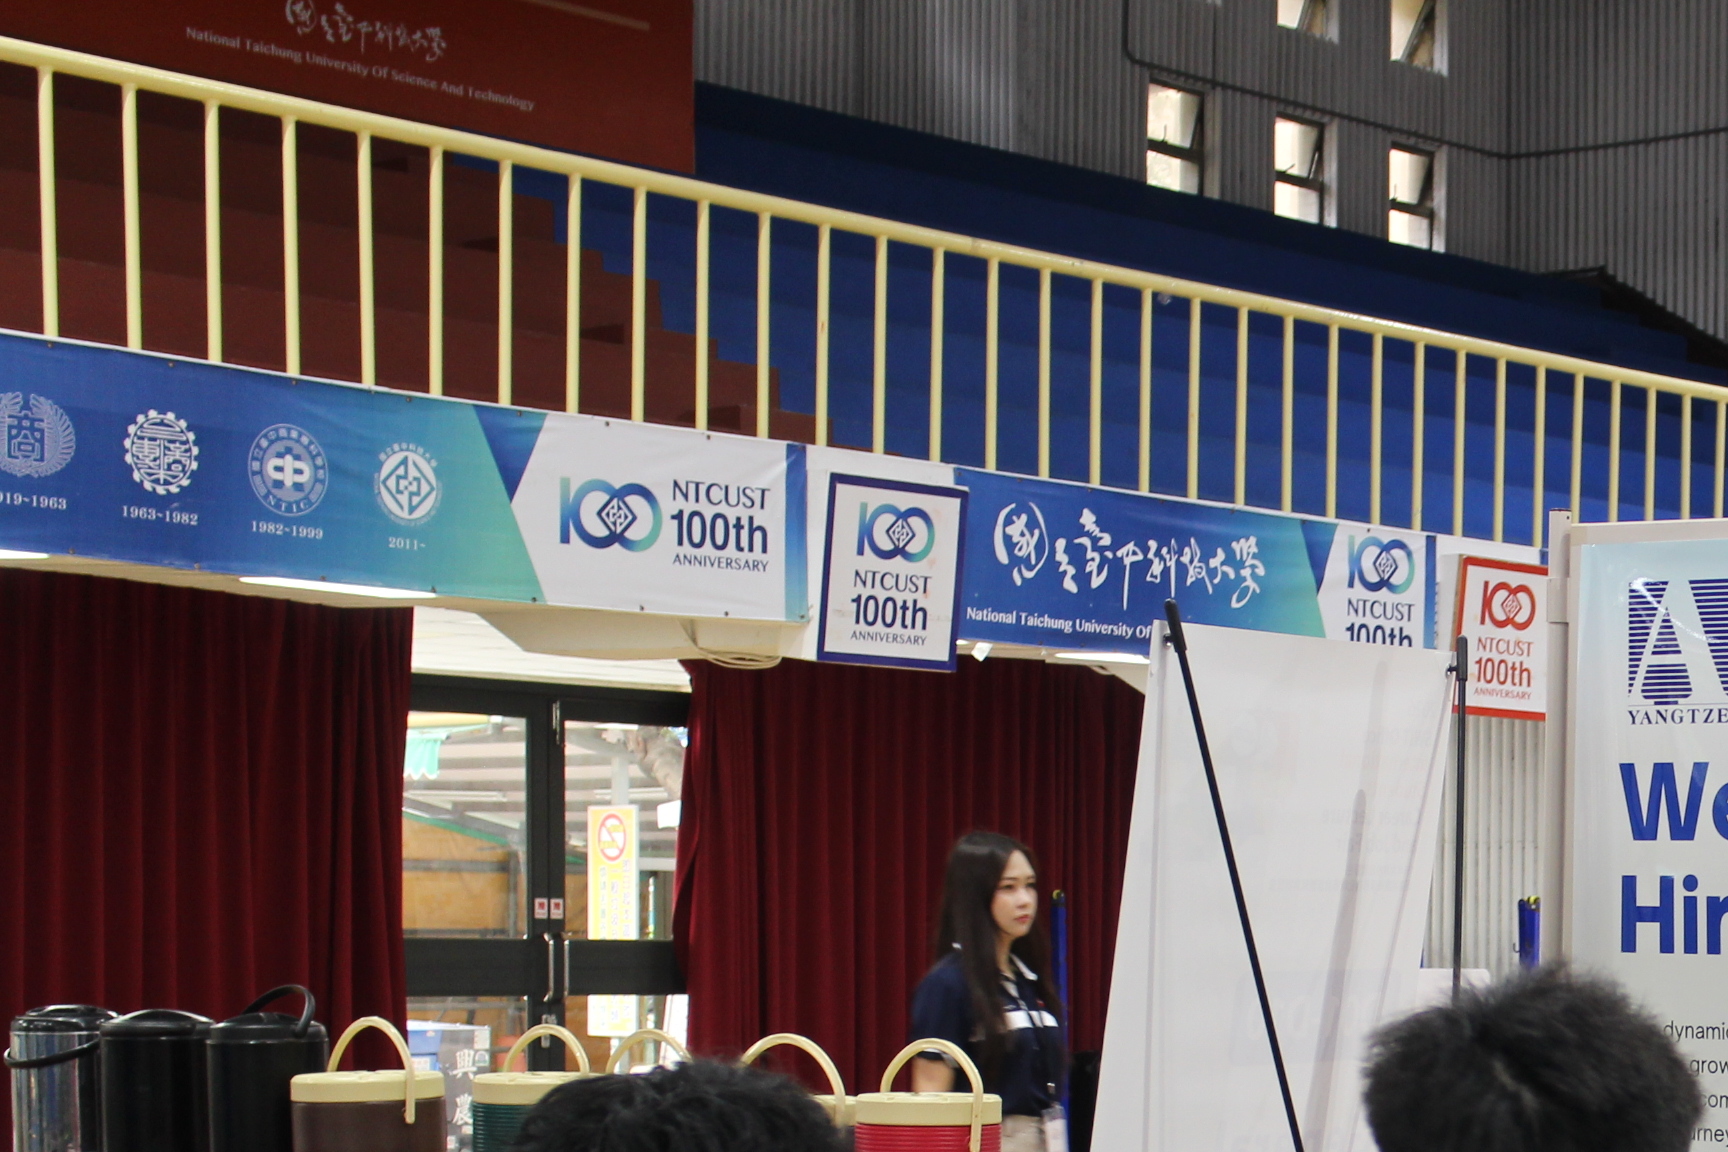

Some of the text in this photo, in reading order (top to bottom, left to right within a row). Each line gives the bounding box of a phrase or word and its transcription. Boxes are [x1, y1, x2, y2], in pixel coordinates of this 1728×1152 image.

[186, 26, 535, 112] National Taichung University Of Science And Technology
[671, 478, 771, 510] NTCUST
[121, 504, 199, 526] 1963~1982
[250, 520, 324, 540] 1982~1999
[670, 508, 768, 554] 100th
[672, 552, 769, 572] ANNIVERSARY
[853, 569, 932, 594] NTCUST
[851, 594, 928, 631] 100th
[1346, 597, 1415, 623] NTCUST
[966, 606, 1151, 640] National Taichung University Of
[851, 630, 927, 646] ANNIVERSARY
[1476, 636, 1534, 657] NTCUST
[1474, 656, 1532, 688] 100th
[1474, 686, 1532, 700] ANNIVERSARY
